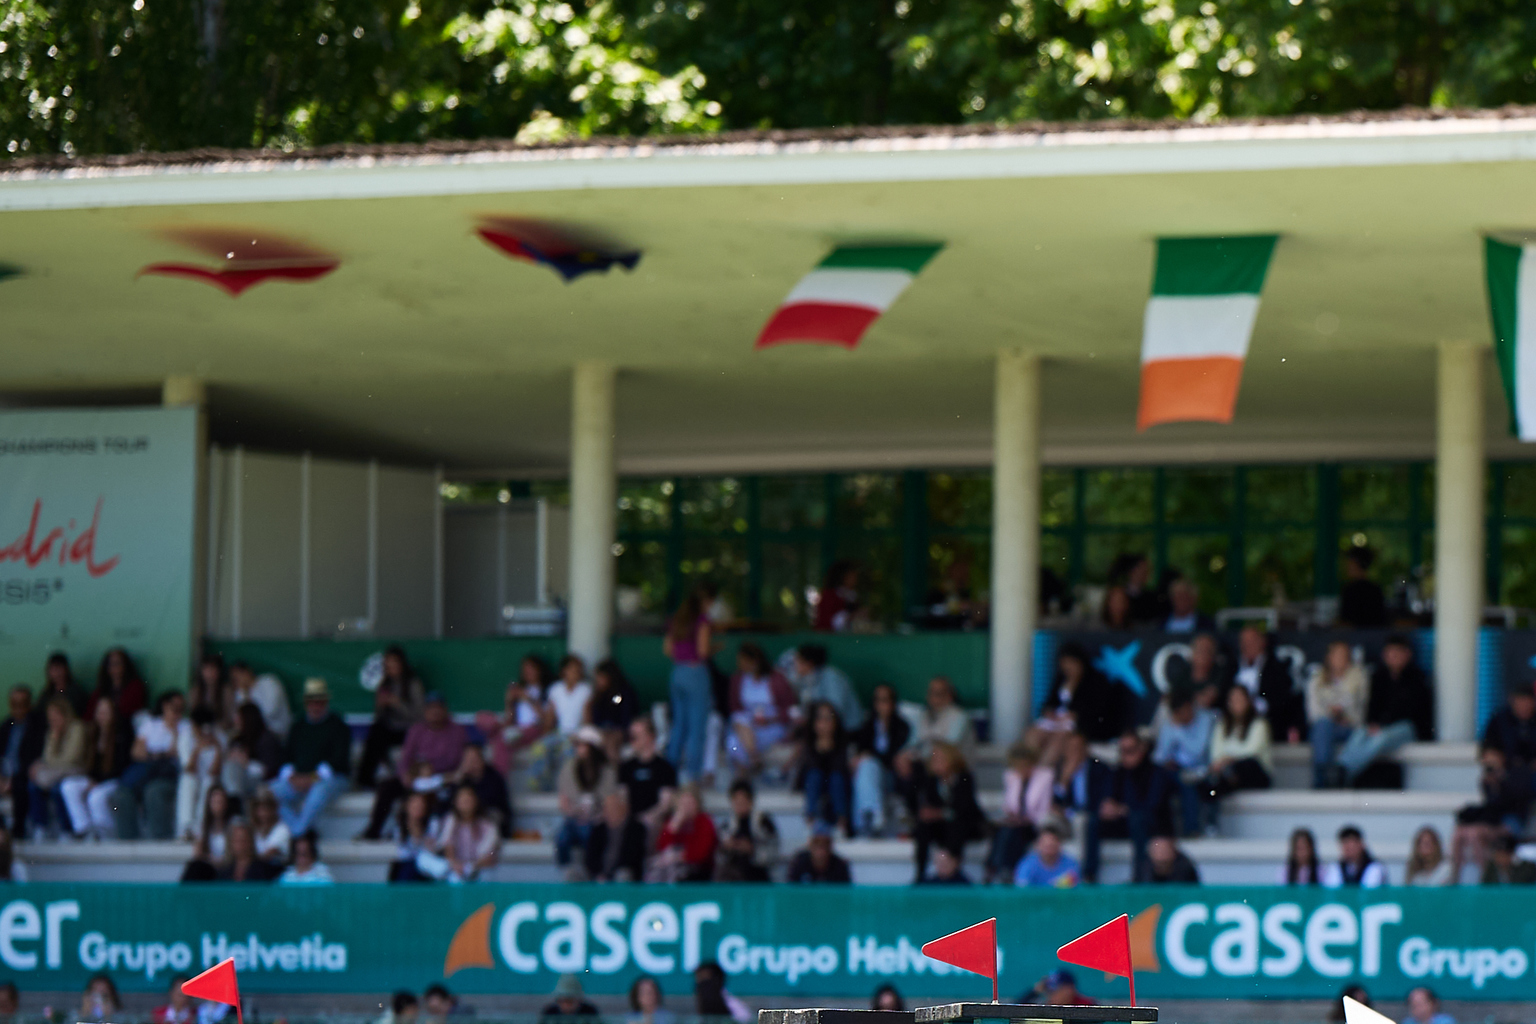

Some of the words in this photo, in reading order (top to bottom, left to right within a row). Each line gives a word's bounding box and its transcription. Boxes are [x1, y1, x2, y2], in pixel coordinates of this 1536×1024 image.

[79, 932, 192, 981] Grupo
[201, 933, 347, 972] Helvetia
[499, 902, 721, 973] caser
[717, 935, 838, 983] Grupo
[1164, 902, 1401, 977] caser
[1400, 937, 1528, 988] Grupo
